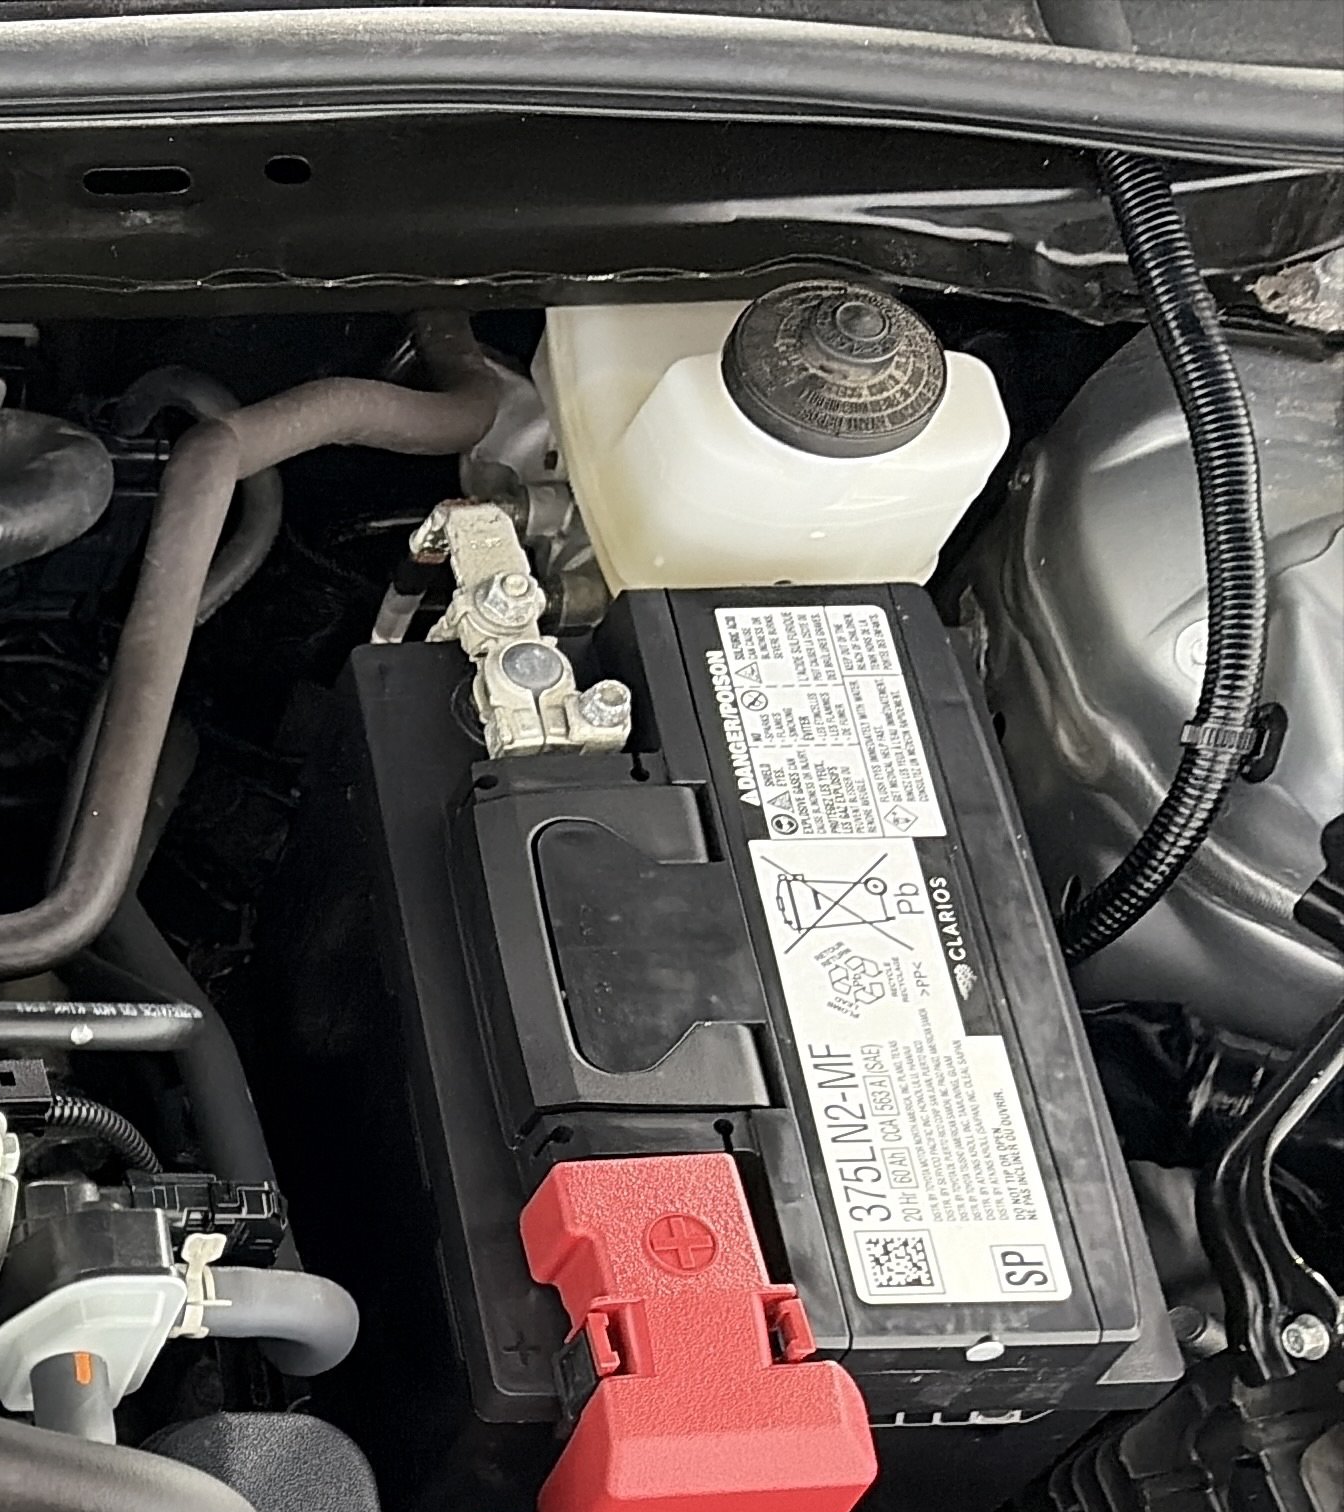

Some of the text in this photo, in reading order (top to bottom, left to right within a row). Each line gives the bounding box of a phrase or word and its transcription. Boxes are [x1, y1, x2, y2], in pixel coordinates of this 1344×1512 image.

[724, 615, 745, 660] SULFURIC ACID
[741, 627, 758, 659] CAN CAUSE
[780, 611, 802, 654] SULFURIQUE
[769, 637, 784, 659] SEVERE
[705, 648, 756, 790] DANGER/POISON
[819, 692, 835, 723] FLAMMES
[834, 703, 848, 725] FUMER
[855, 703, 867, 720] WITH
[750, 732, 762, 742] NO
[860, 722, 879, 762] IMMEDIATELY
[877, 742, 890, 759] HELP
[894, 750, 906, 767] YEUX
[759, 763, 775, 787] SHIELD
[870, 764, 884, 780] EYES
[884, 760, 898, 788] MEDICAL
[786, 758, 814, 834] EXPLOSIVE GASES CAN
[818, 783, 832, 796] LES
[826, 766, 854, 834] LES GAZ EXPLOSIFS
[876, 781, 890, 803] FLUSH
[890, 790, 903, 802] GET
[849, 805, 865, 834] PEUVENT
[893, 882, 924, 914] Pb
[929, 877, 966, 961] CLARIOS
[852, 972, 863, 987] Pb
[883, 962, 898, 997] RECYCLE
[891, 956, 909, 1003] RECYCLAGE
[943, 1055, 957, 1077] GUAM
[807, 1043, 892, 1222] 375LN2-MF
[860, 1043, 923, 1222] 20 Hr 60 Ah CCA 563 A (SAE)
[923, 1129, 939, 1155] PACIFIC
[1003, 1128, 1016, 1141] OU
[998, 1153, 1012, 1167] OR
[1007, 1143, 1028, 1185] INCLINER
[1002, 1169, 1015, 1183] TIP
[1007, 1187, 1021, 1205] NOT
[1019, 1188, 1034, 1206] PAS
[1013, 1207, 1026, 1221] DO
[1026, 1209, 1038, 1220] NE
[1000, 1250, 1048, 1286] SP
